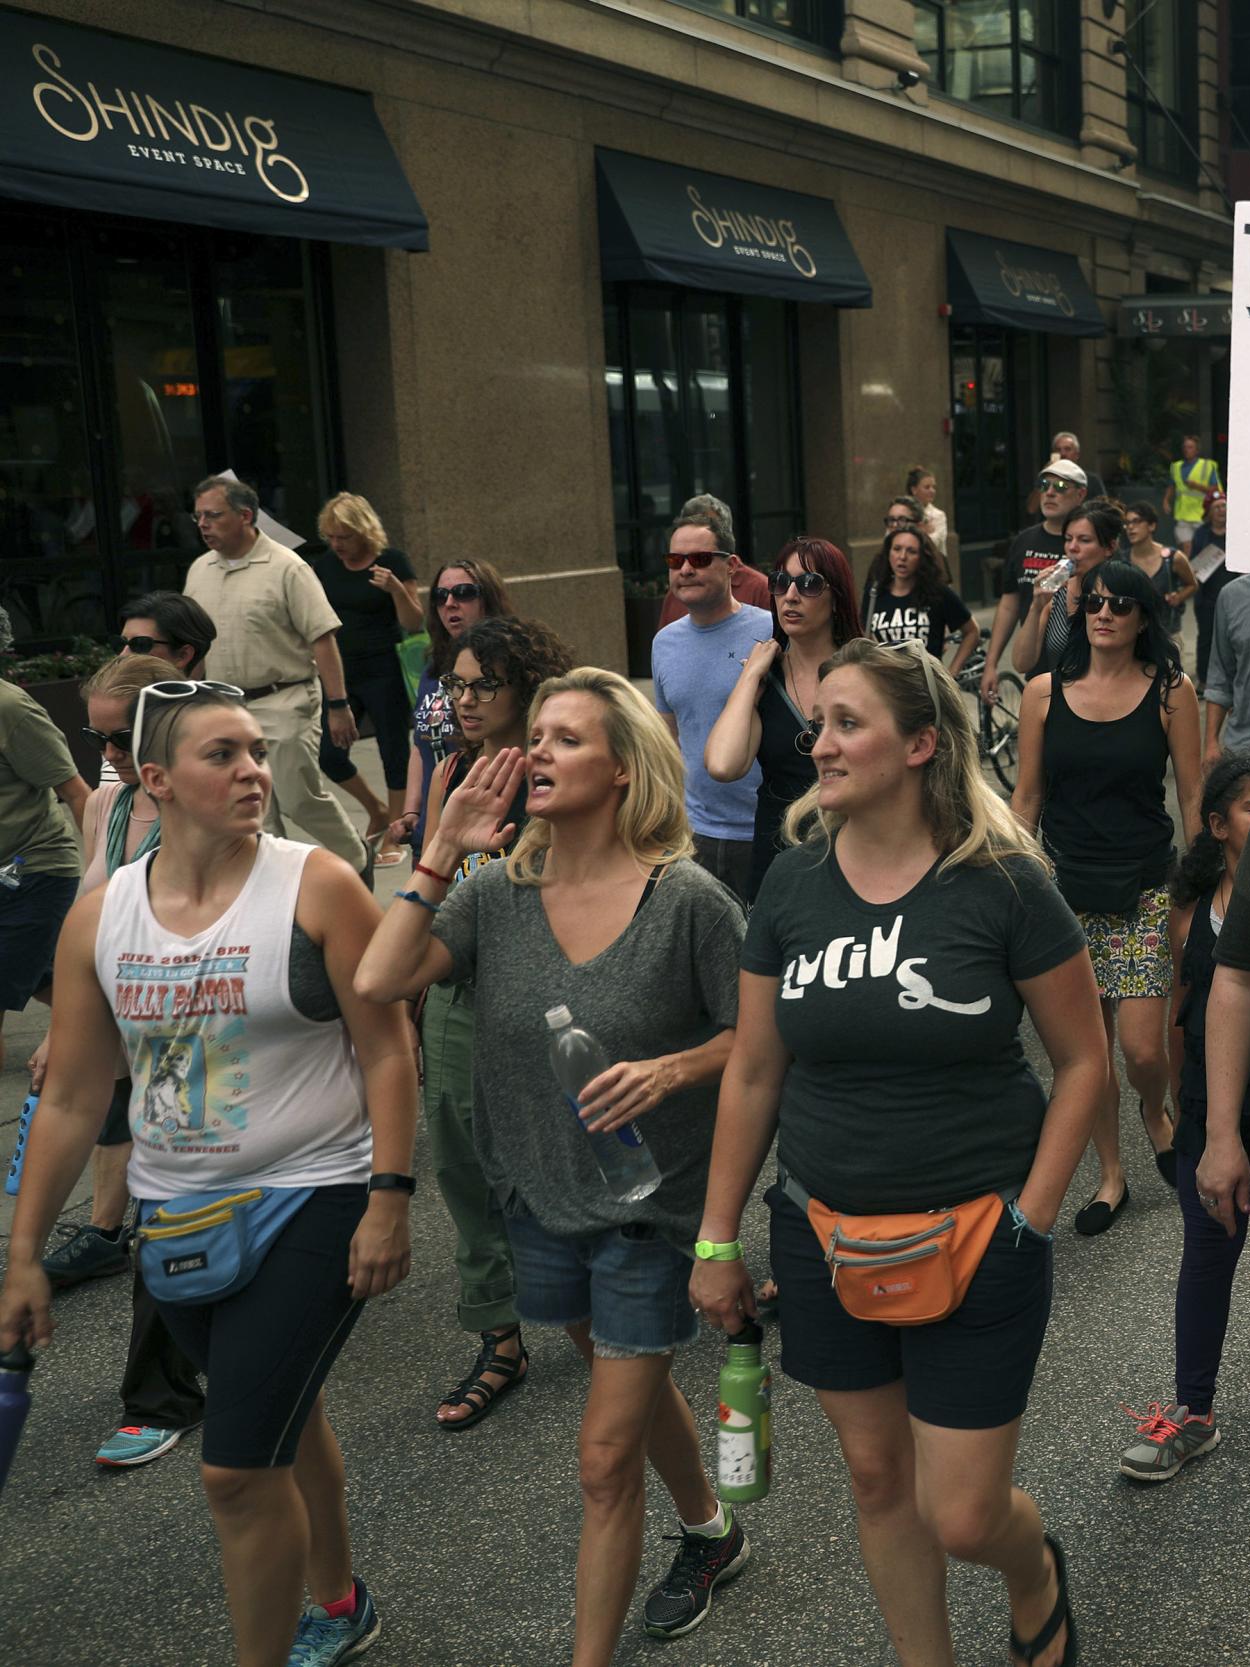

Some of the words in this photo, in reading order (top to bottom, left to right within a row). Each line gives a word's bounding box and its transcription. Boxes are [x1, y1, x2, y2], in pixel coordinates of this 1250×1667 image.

[127, 144, 186, 165] EVENT
[193, 155, 247, 176] SPACE
[118, 952, 155, 964] JUNE
[216, 945, 251, 956] 8PM
[172, 1144, 240, 1153] TENNESSEE
